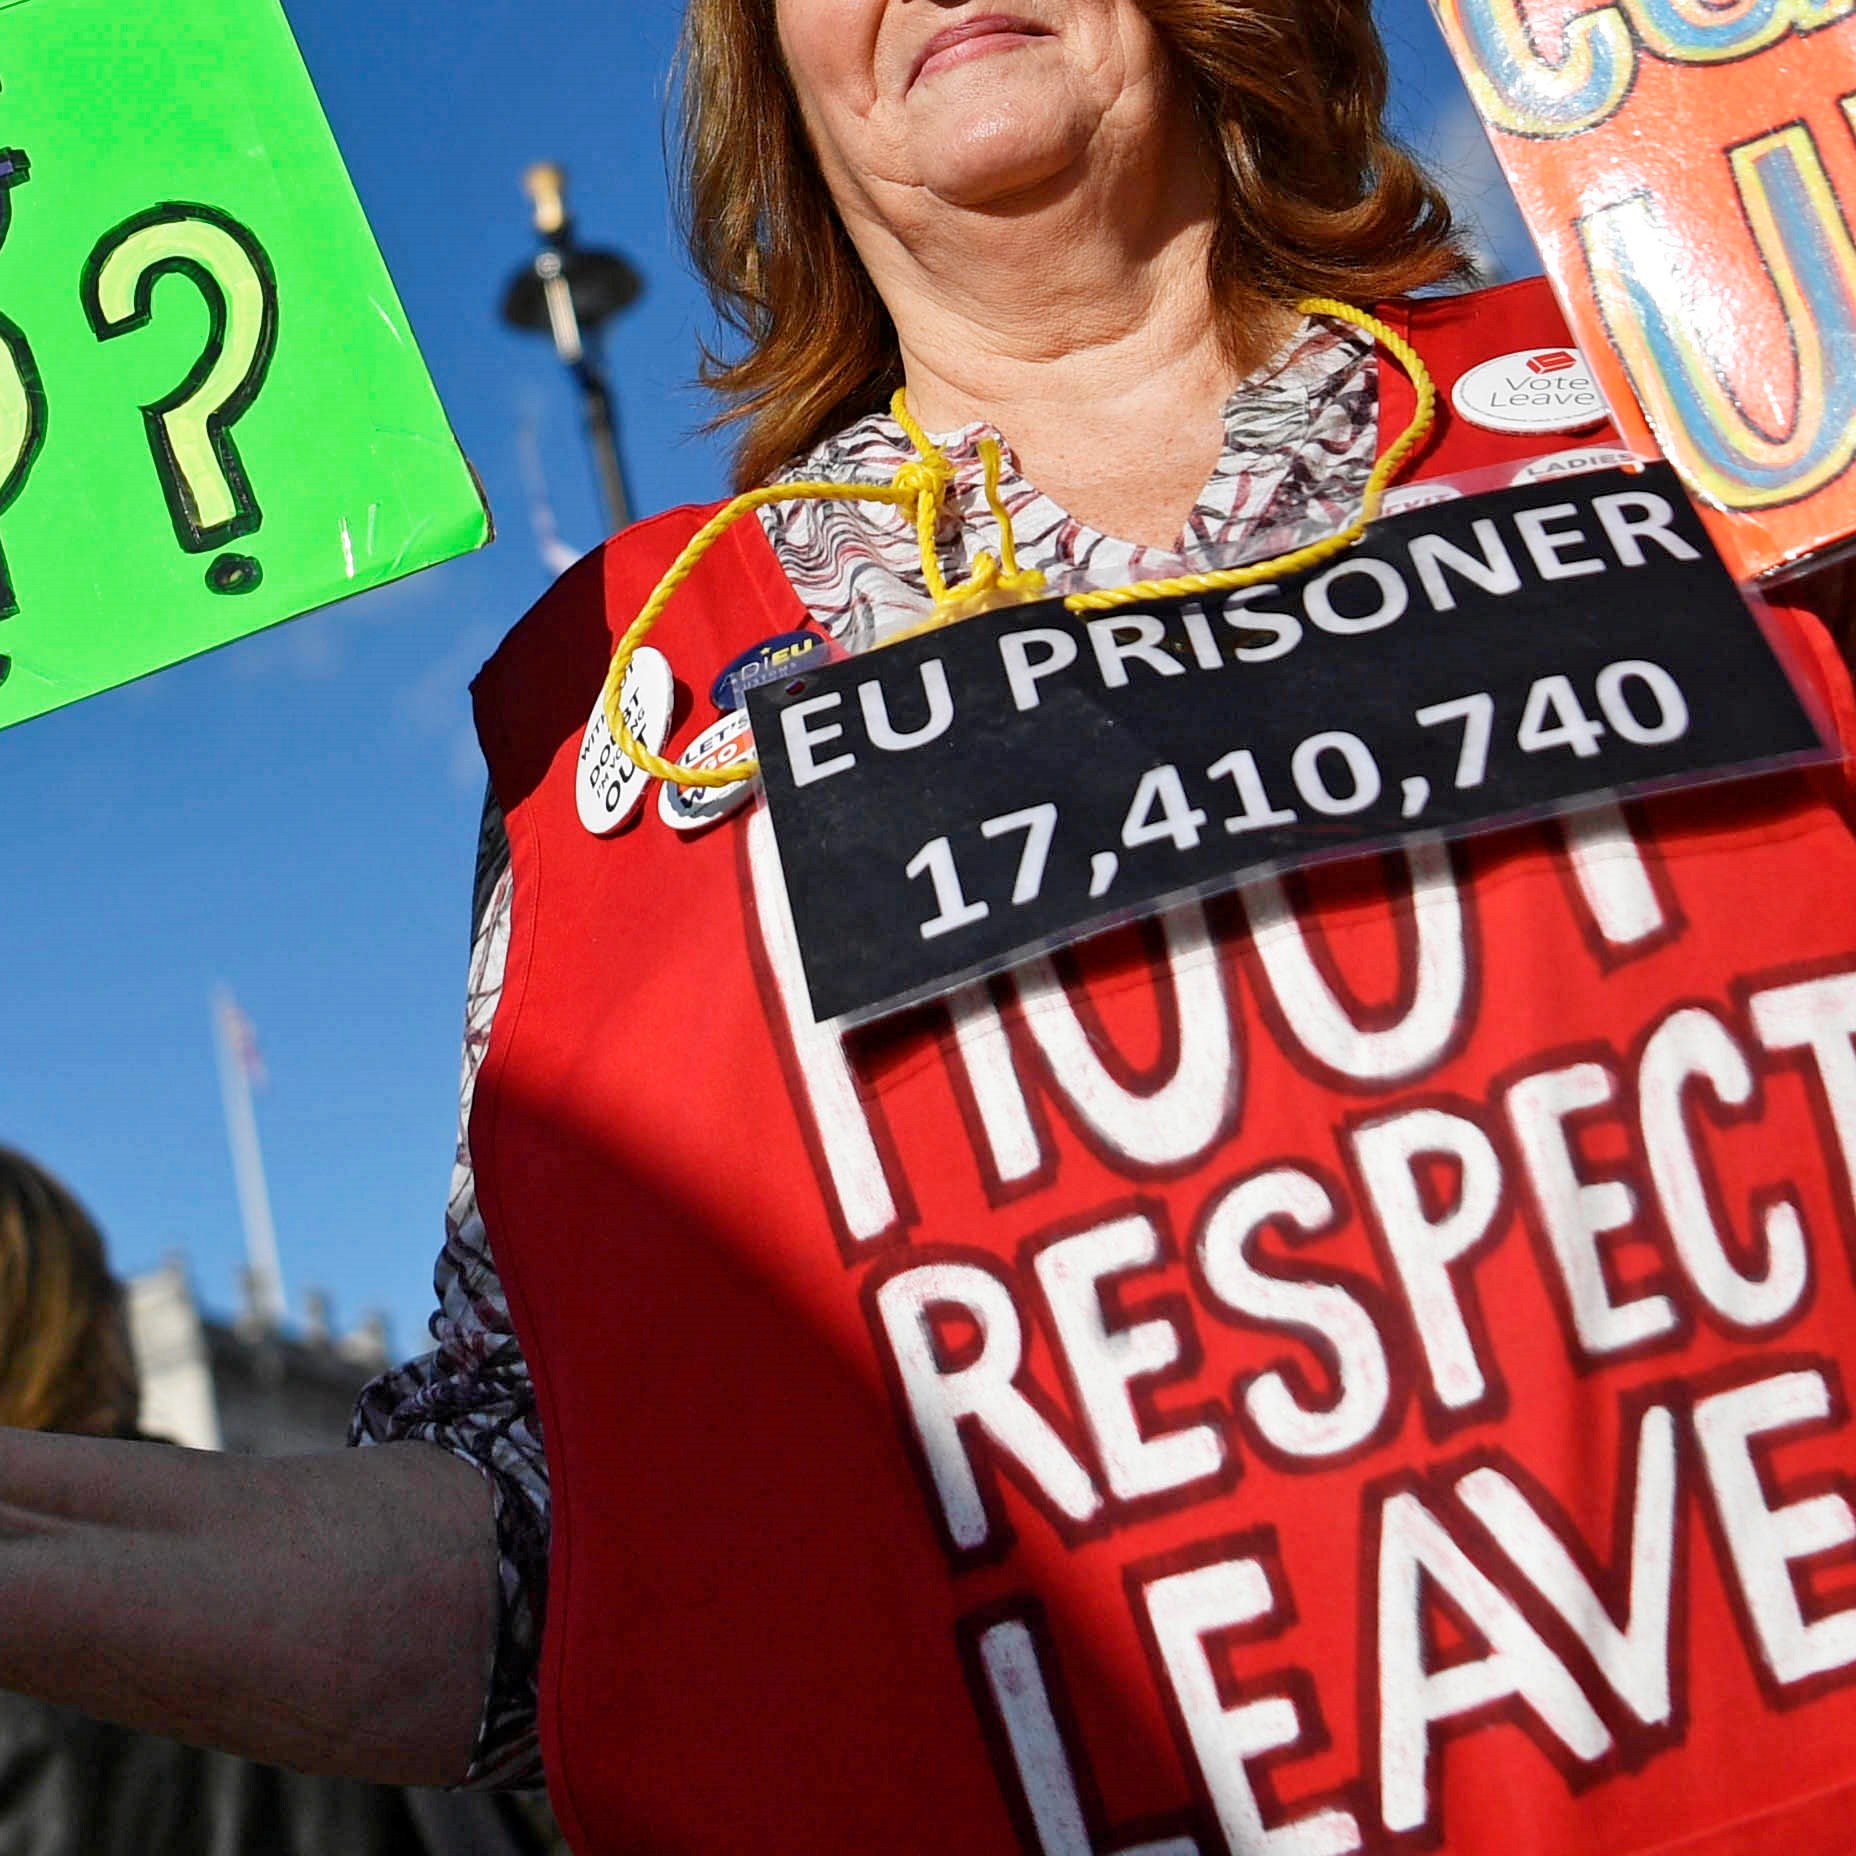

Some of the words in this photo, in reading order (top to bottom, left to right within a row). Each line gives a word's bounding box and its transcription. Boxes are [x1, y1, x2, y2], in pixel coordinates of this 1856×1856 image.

[1490, 391, 1595, 407] Leave
[1505, 375, 1590, 392] Vote
[778, 662, 957, 789] EU
[997, 486, 1706, 712] PRISONER
[903, 660, 1690, 941] 17,410,740
